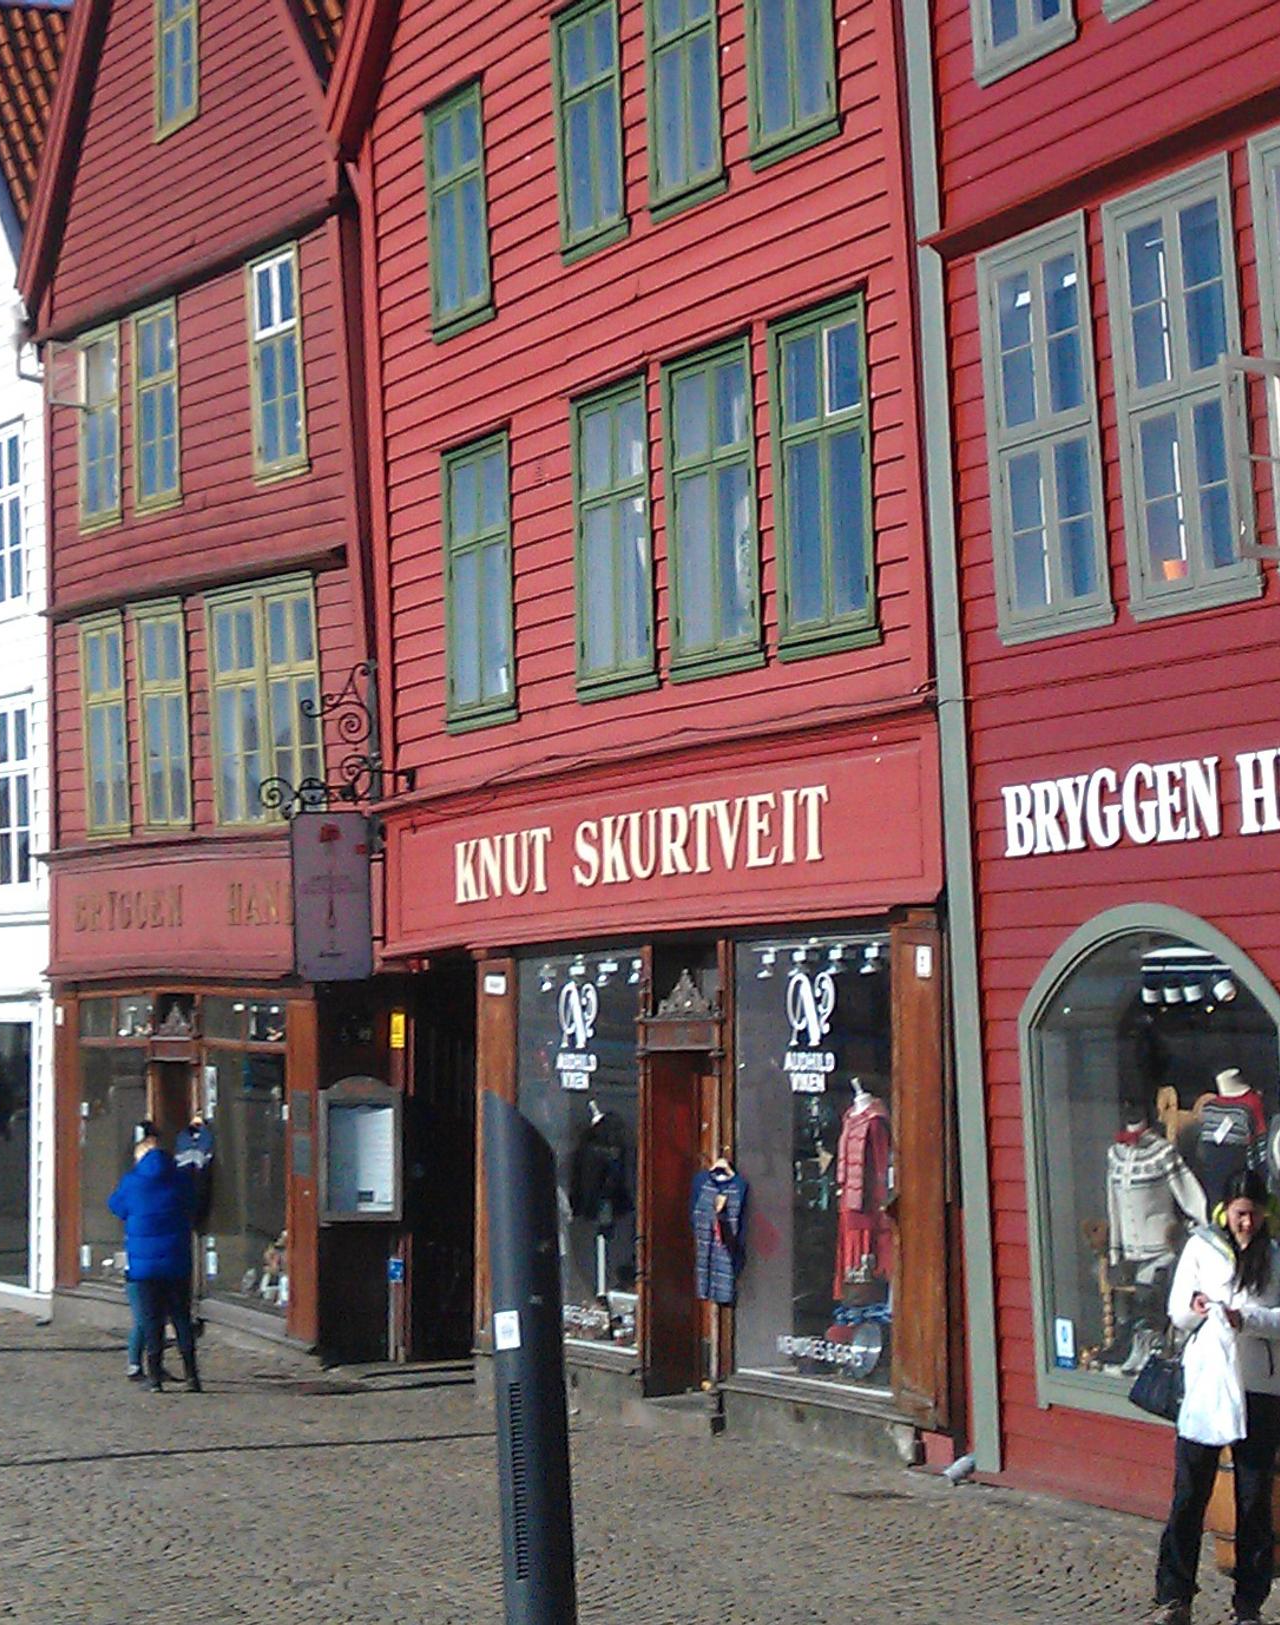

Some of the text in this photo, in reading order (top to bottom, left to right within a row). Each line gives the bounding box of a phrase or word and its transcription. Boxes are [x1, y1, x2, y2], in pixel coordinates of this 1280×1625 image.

[1001, 755, 1221, 858] BRYGGEN
[455, 785, 829, 904] KNUT SKURTVEIT
[73, 884, 184, 932] BRYGGEN
[227, 880, 294, 926] HAN
[783, 1052, 836, 1072] AUDHILD
[790, 1073, 826, 1092] VIKEN
